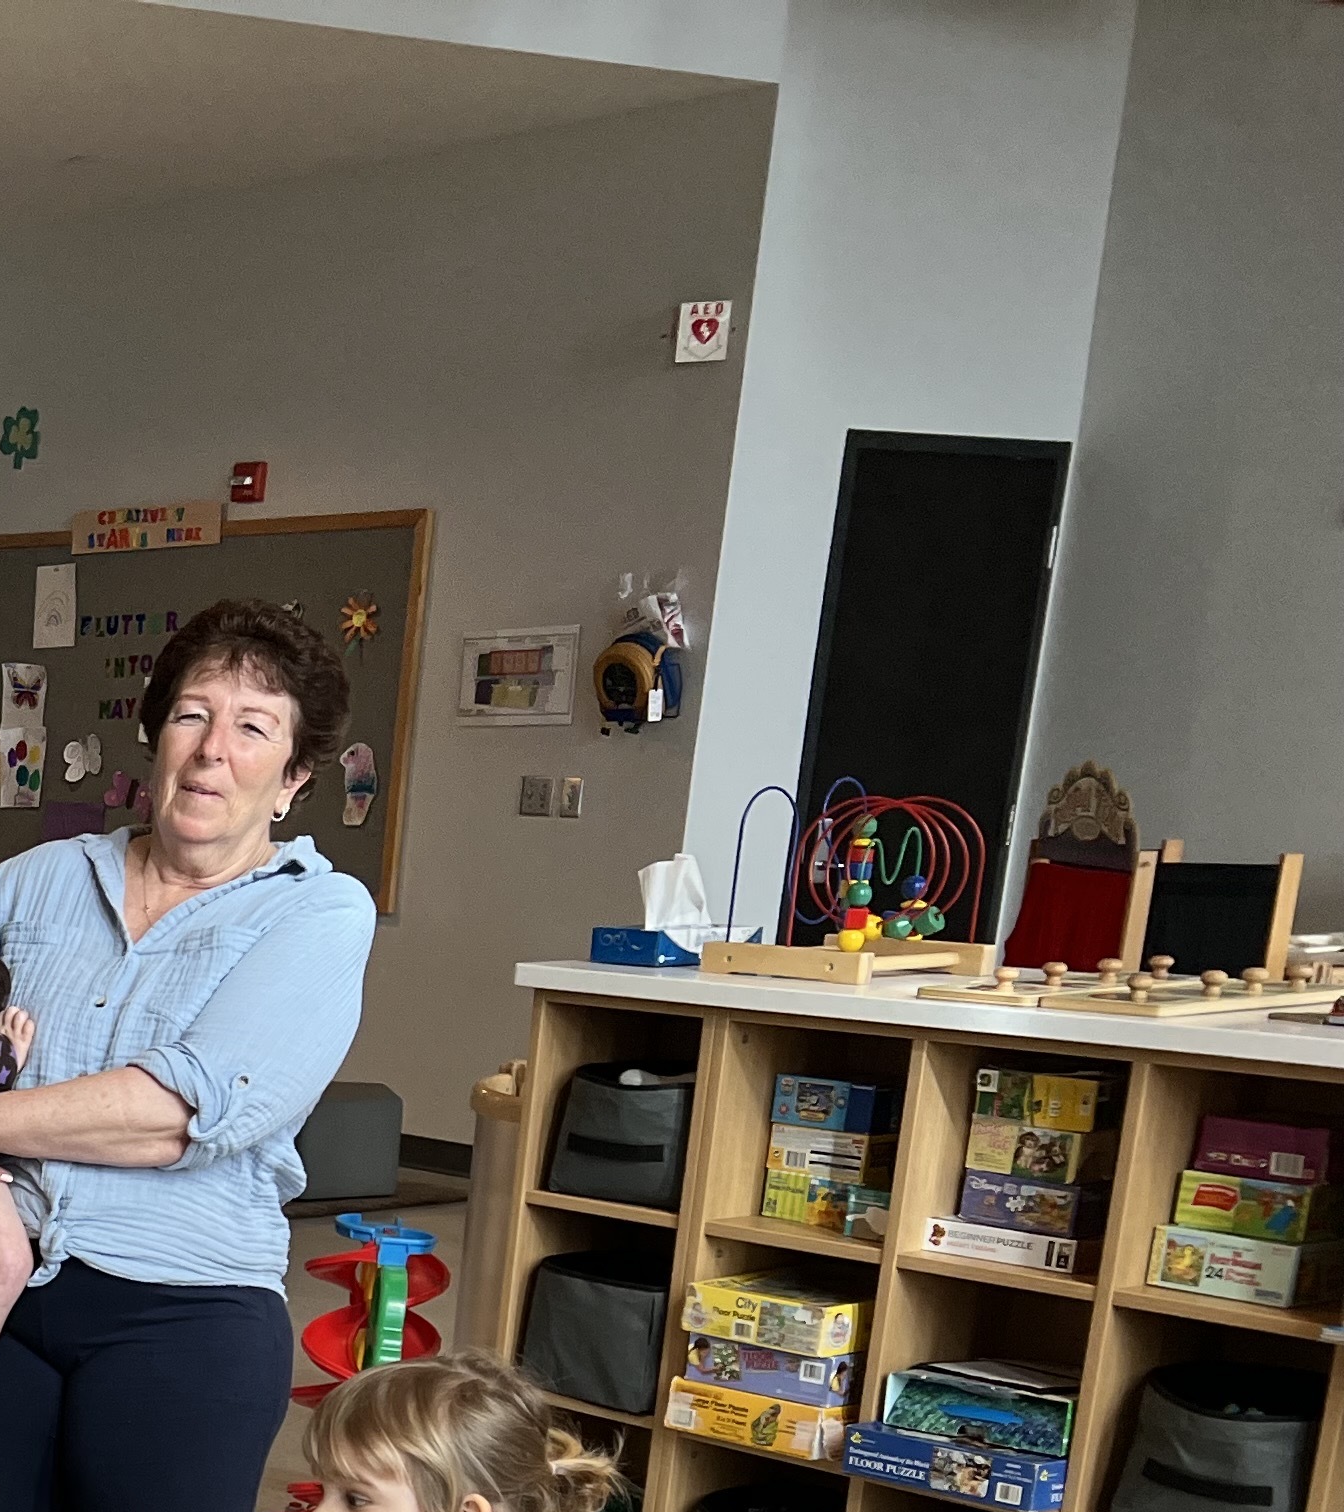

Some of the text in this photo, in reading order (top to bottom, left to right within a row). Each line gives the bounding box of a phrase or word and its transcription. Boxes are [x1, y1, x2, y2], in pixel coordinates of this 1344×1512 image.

[690, 302, 724, 316] AED
[97, 507, 185, 525] CREATIVIY
[98, 698, 137, 719] MAY
[947, 1228, 997, 1245] BEGINNER
[996, 1236, 1034, 1251] PUZZLE
[1205, 1265, 1224, 1280] 24
[736, 1297, 759, 1313] City
[848, 1456, 926, 1481] FLOOR PUZZLE
